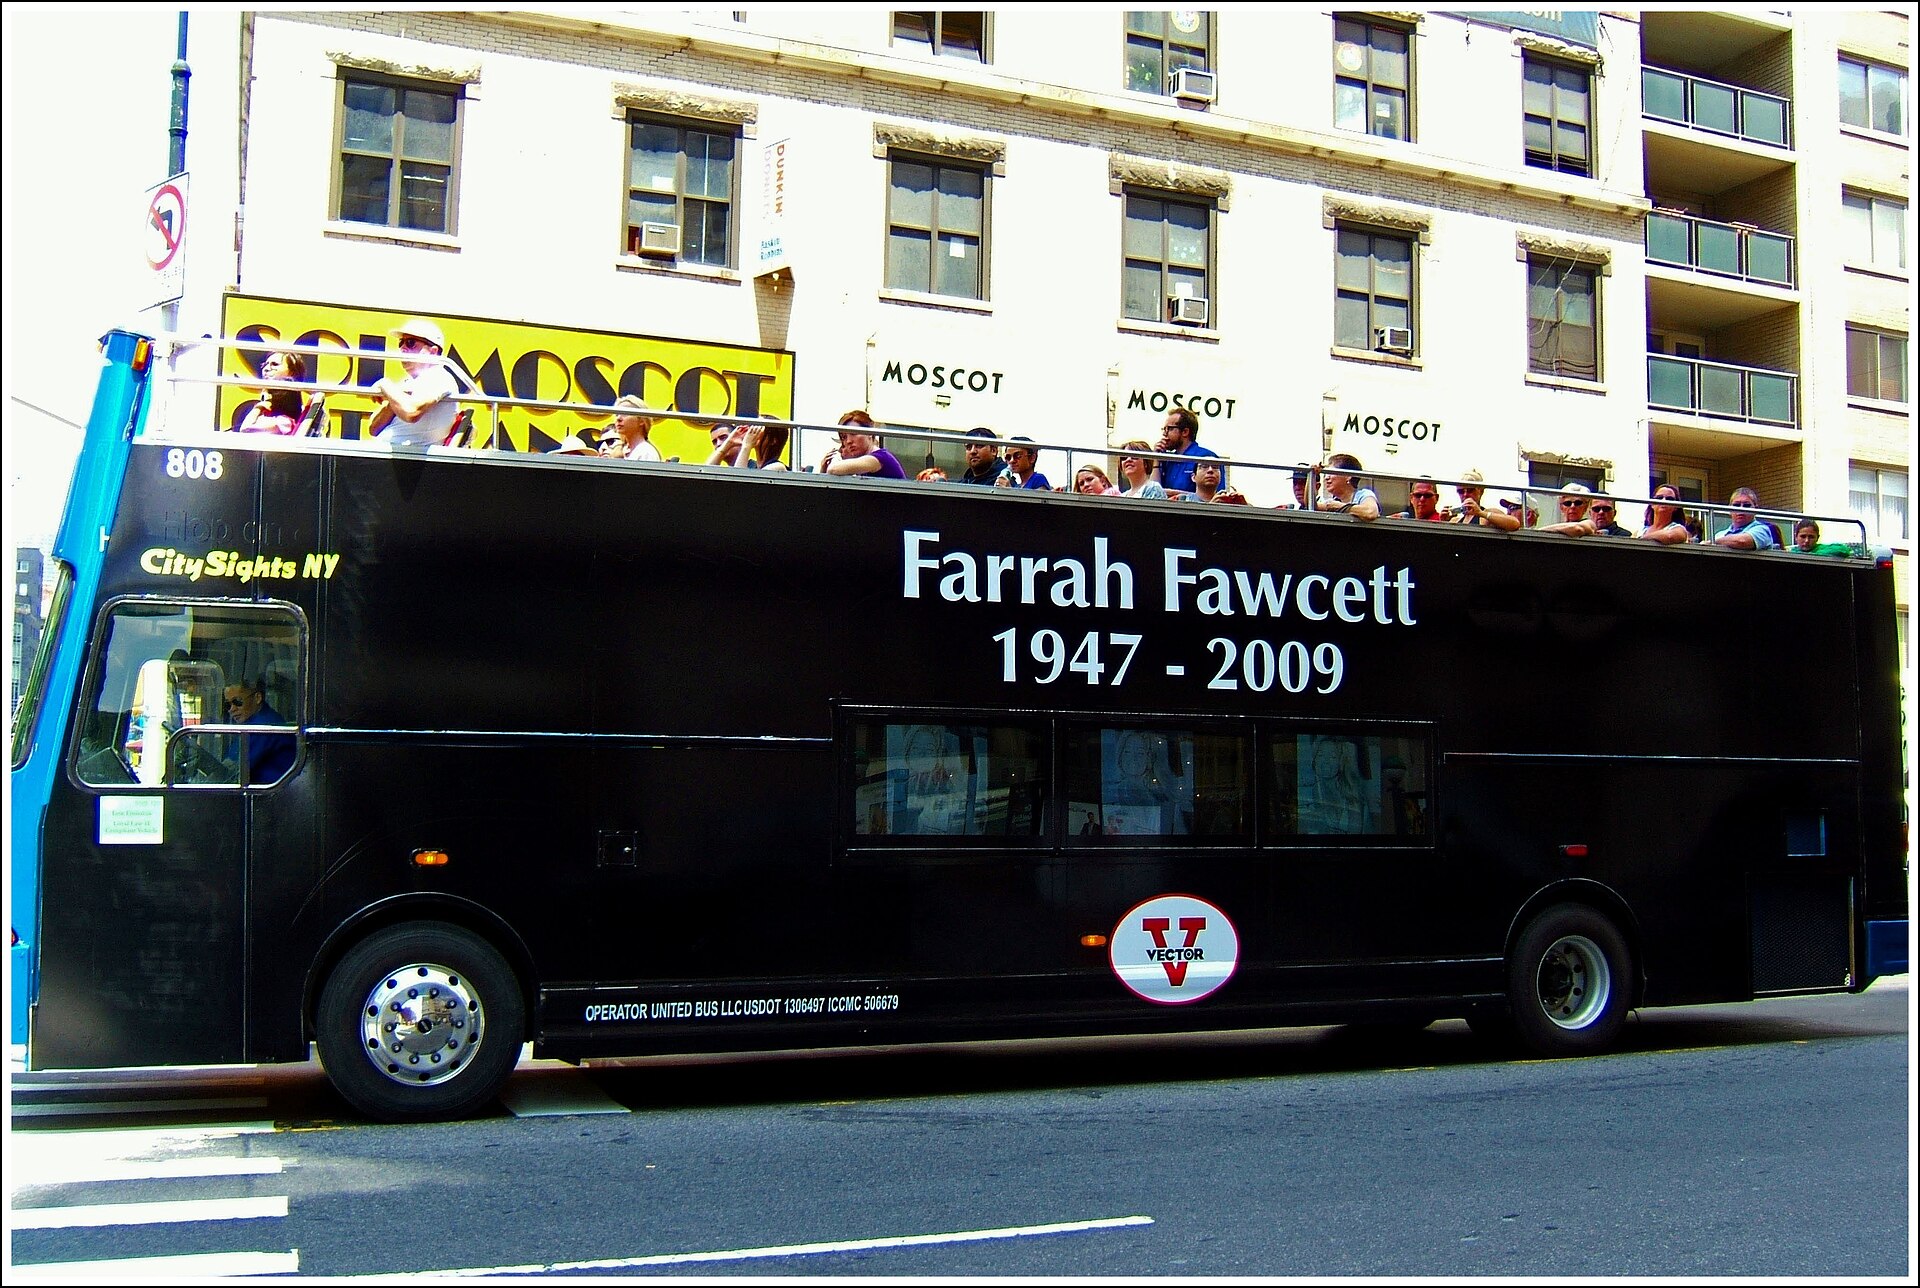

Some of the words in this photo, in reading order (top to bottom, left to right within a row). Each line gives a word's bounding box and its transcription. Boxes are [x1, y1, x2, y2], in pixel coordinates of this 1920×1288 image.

[443, 343, 776, 425] MOSCOT
[882, 360, 1004, 394] MOSCOT
[1127, 389, 1236, 419] MOSCOT
[1343, 413, 1441, 442] MOSCOT
[166, 448, 224, 480] 808
[302, 553, 340, 579] NY
[902, 530, 1134, 609] Farrah
[1163, 547, 1417, 626] Fawcett
[992, 627, 1143, 686] 1947
[1166, 665, 1185, 676] -
[1206, 637, 1344, 694] 2009
[1146, 948, 1205, 961] VECTOR
[585, 1003, 648, 1021] OPERATOR
[651, 1001, 693, 1019] UNITED
[695, 1000, 719, 1017] BUS
[720, 1000, 742, 1016] LLC
[743, 998, 782, 1015] USDOT
[783, 997, 826, 1014] 1306497
[827, 996, 862, 1012] ICCMC
[864, 994, 899, 1010] 506679
